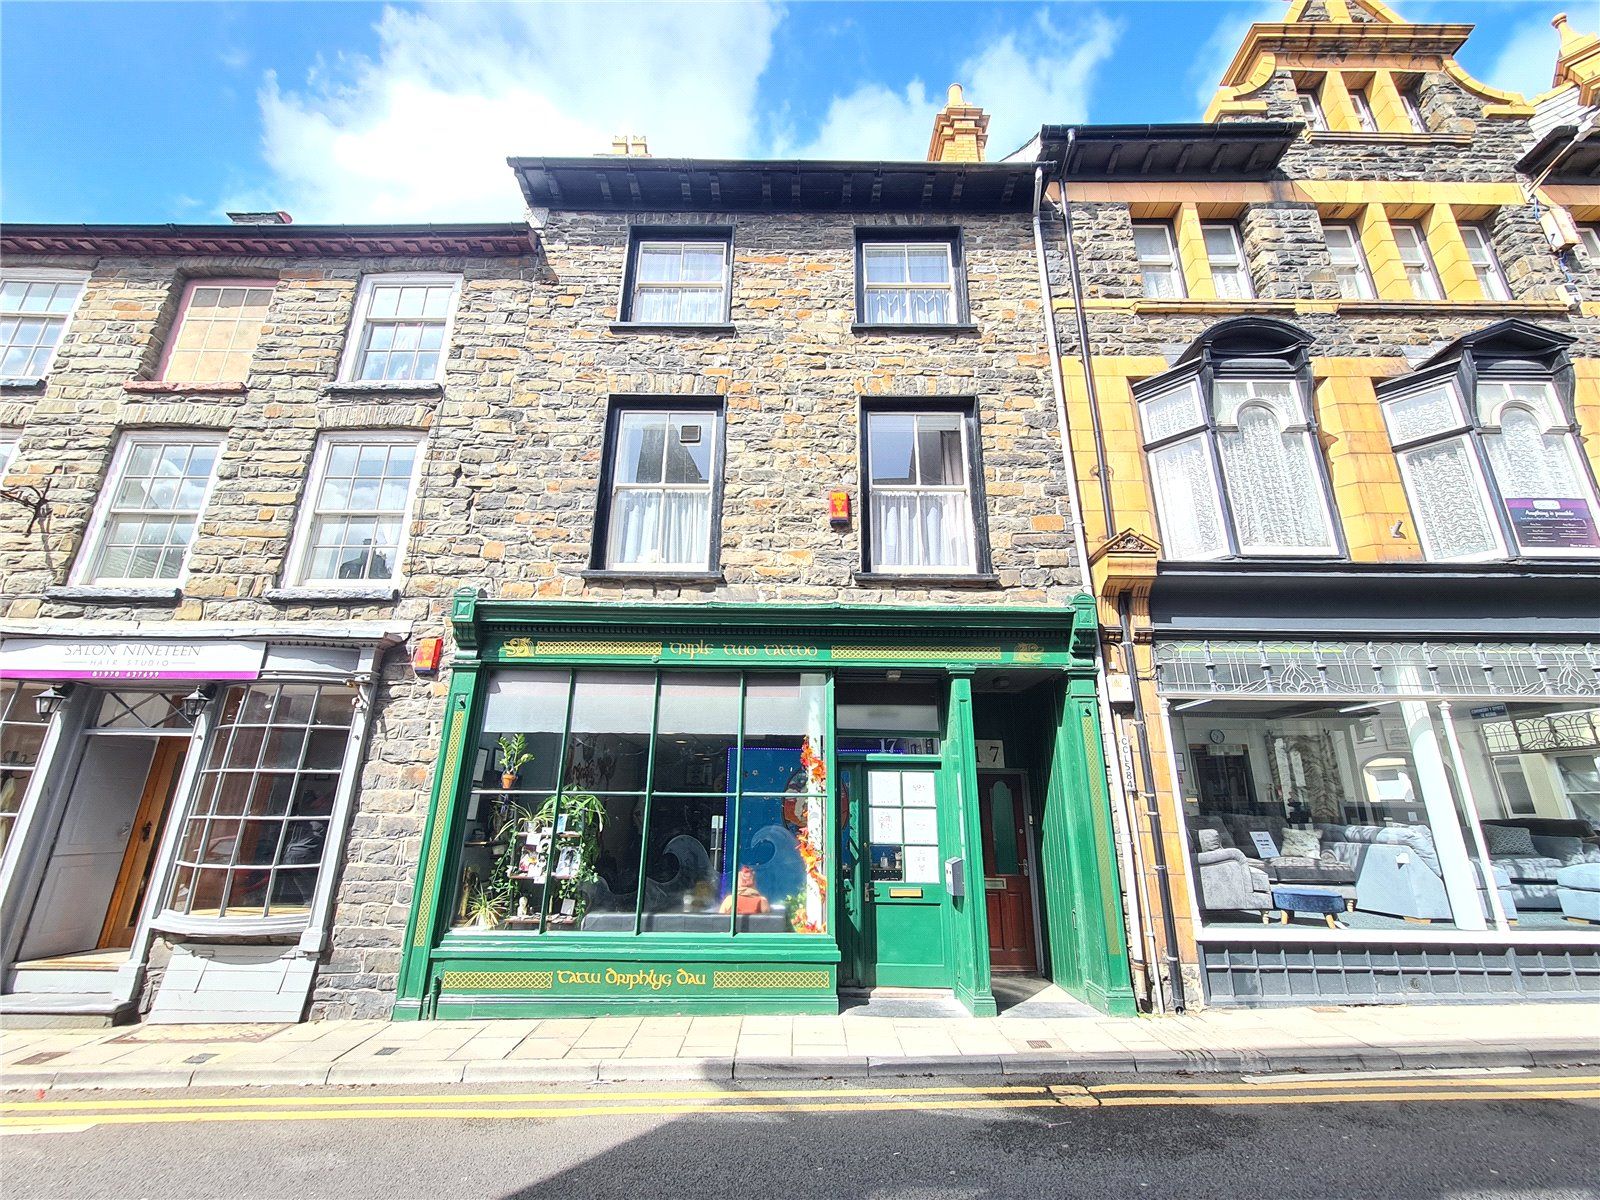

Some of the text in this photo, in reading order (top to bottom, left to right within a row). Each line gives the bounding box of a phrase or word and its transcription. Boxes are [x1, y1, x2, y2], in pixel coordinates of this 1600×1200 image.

[64, 644, 201, 656] SALON NINETEEN
[880, 738, 898, 754] 17
